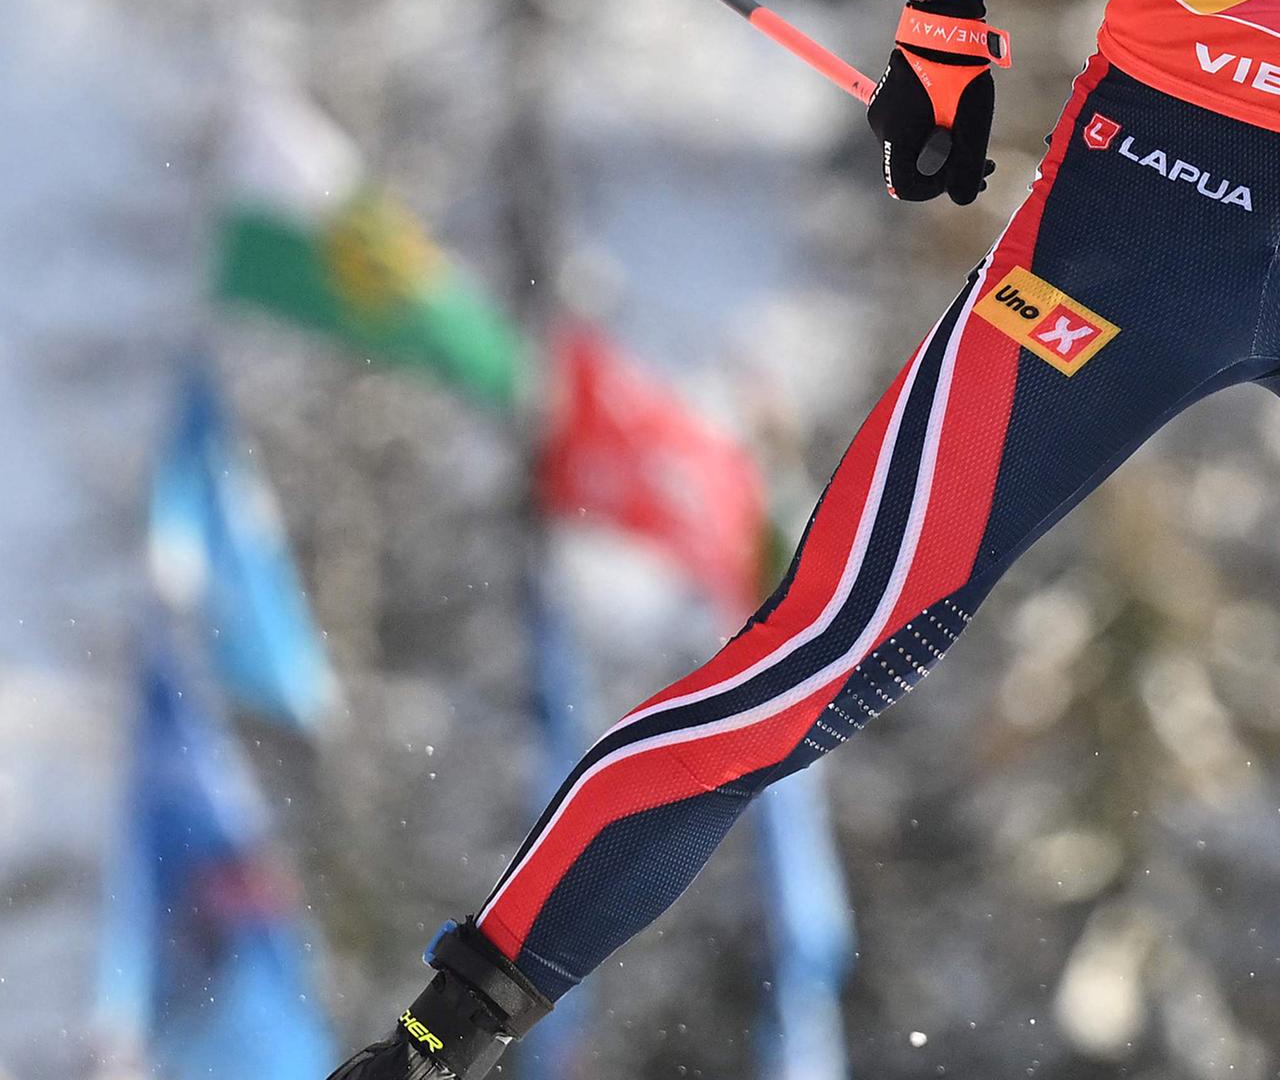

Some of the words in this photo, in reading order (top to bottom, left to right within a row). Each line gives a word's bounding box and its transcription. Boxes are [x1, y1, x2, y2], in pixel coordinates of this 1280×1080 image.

[1118, 135, 1253, 212] LAPUA
[995, 284, 1040, 320] Uno
[1036, 315, 1095, 355] X
